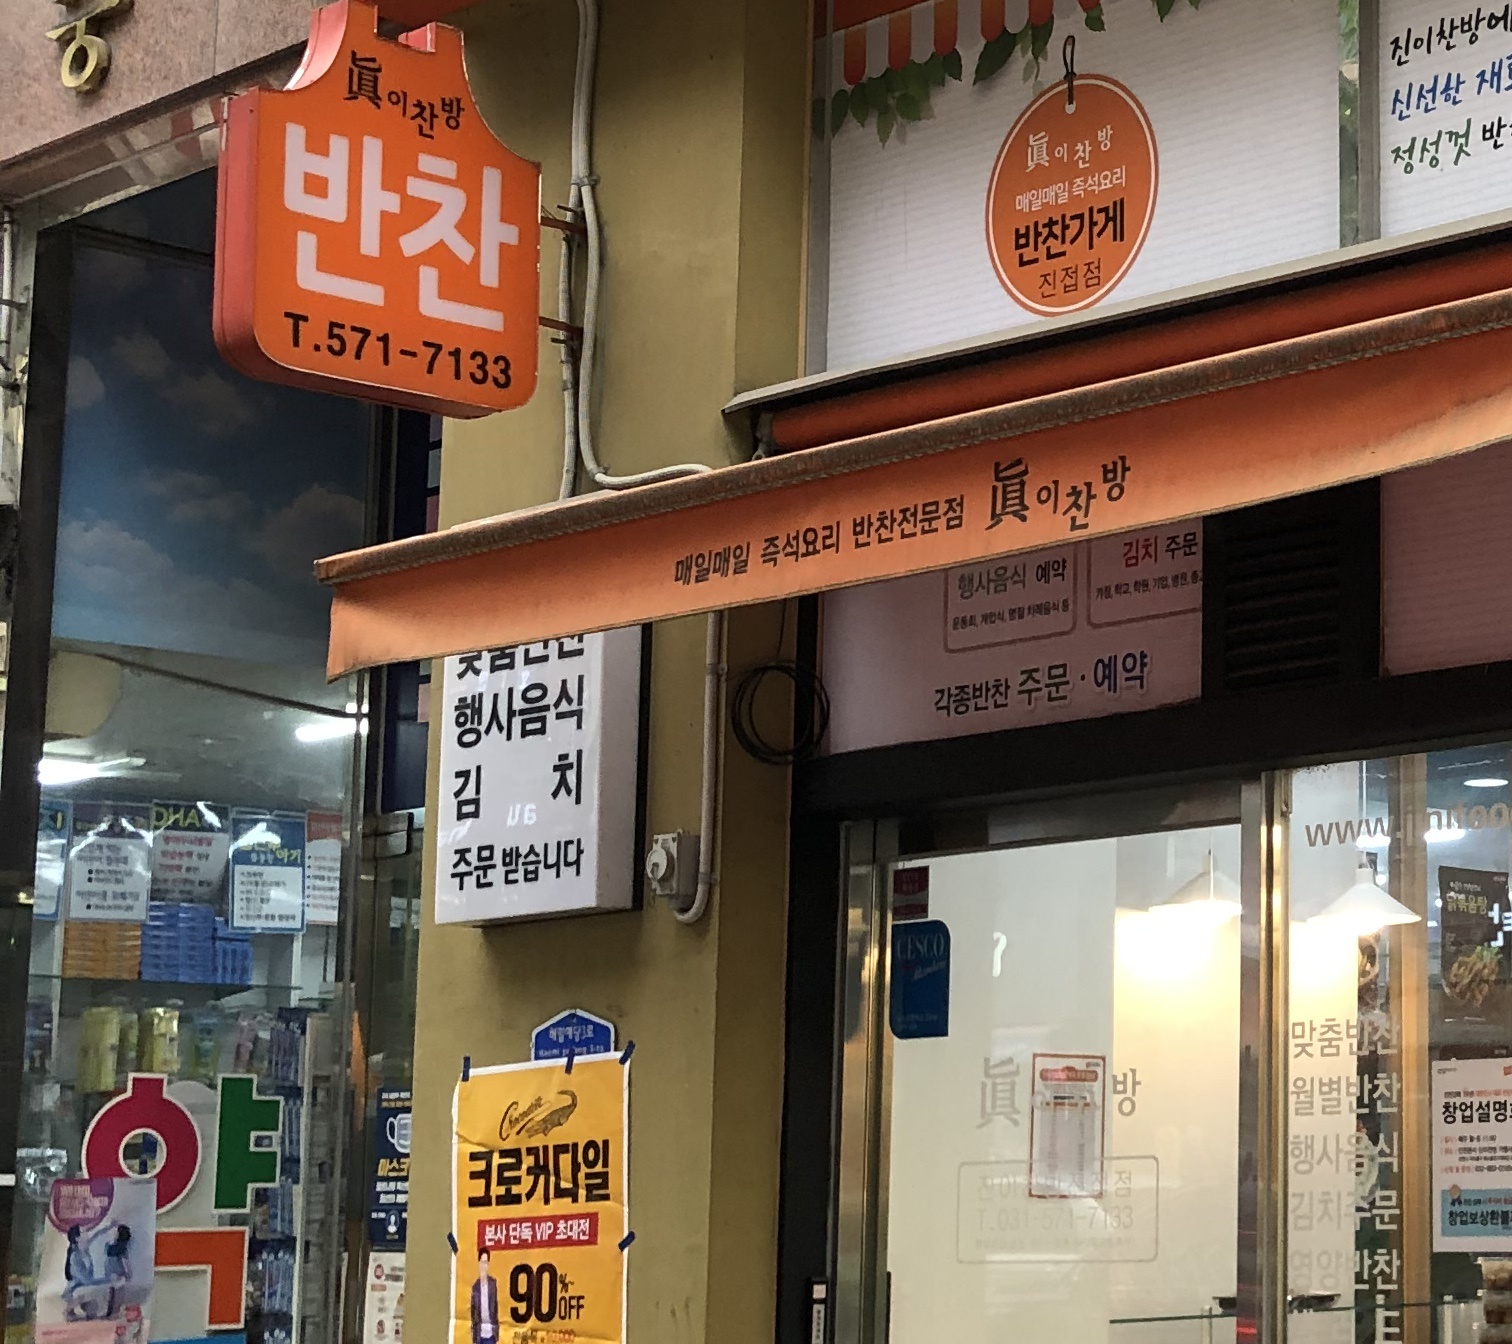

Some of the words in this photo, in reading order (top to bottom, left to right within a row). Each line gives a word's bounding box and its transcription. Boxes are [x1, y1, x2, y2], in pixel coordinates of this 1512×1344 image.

[344, 51, 466, 140] 眞이찬방
[1390, 71, 1466, 121] 신선한
[1024, 124, 1115, 174] 眞이찬방
[1390, 118, 1472, 175] 정성껏
[1014, 180, 1069, 213] 매일매일
[1071, 165, 1127, 199] 즉석요리
[283, 121, 520, 333] 반찬
[1013, 197, 1126, 269] 반찬가게
[1038, 259, 1103, 301] 진접점
[284, 312, 513, 390] T.571-7133
[985, 456, 1132, 533] 眞이찬방
[675, 541, 752, 588] 매일매일
[760, 521, 842, 569] 즉석요리
[852, 494, 965, 552] 반찬전문점
[1122, 535, 1159, 569] 김치
[1164, 531, 1199, 560] 주문
[958, 562, 1027, 601] 행사음식
[1035, 557, 1067, 585] 예약
[934, 677, 1011, 719] 각종반찬
[1016, 662, 1071, 708] 주문
[1093, 649, 1149, 696] 예약
[454, 674, 585, 749] 행사음식
[450, 844, 497, 891] 주문
[501, 838, 585, 886] 받습니다
[897, 933, 945, 961] CESCO
[1291, 1017, 1400, 1058] 맞춤반찬
[1290, 1072, 1401, 1116] 월별반찬
[467, 1139, 611, 1210] 크로커다일
[1290, 1132, 1399, 1176] 행사음식
[82, 1073, 283, 1329] 약
[1290, 1190, 1401, 1232] 김치주문
[484, 1224, 507, 1245] 본사
[509, 1222, 533, 1245] 단독
[535, 1221, 554, 1241] VIP
[555, 1218, 590, 1241] 초대전
[509, 1262, 558, 1324] 90
[558, 1295, 586, 1321] OFF
